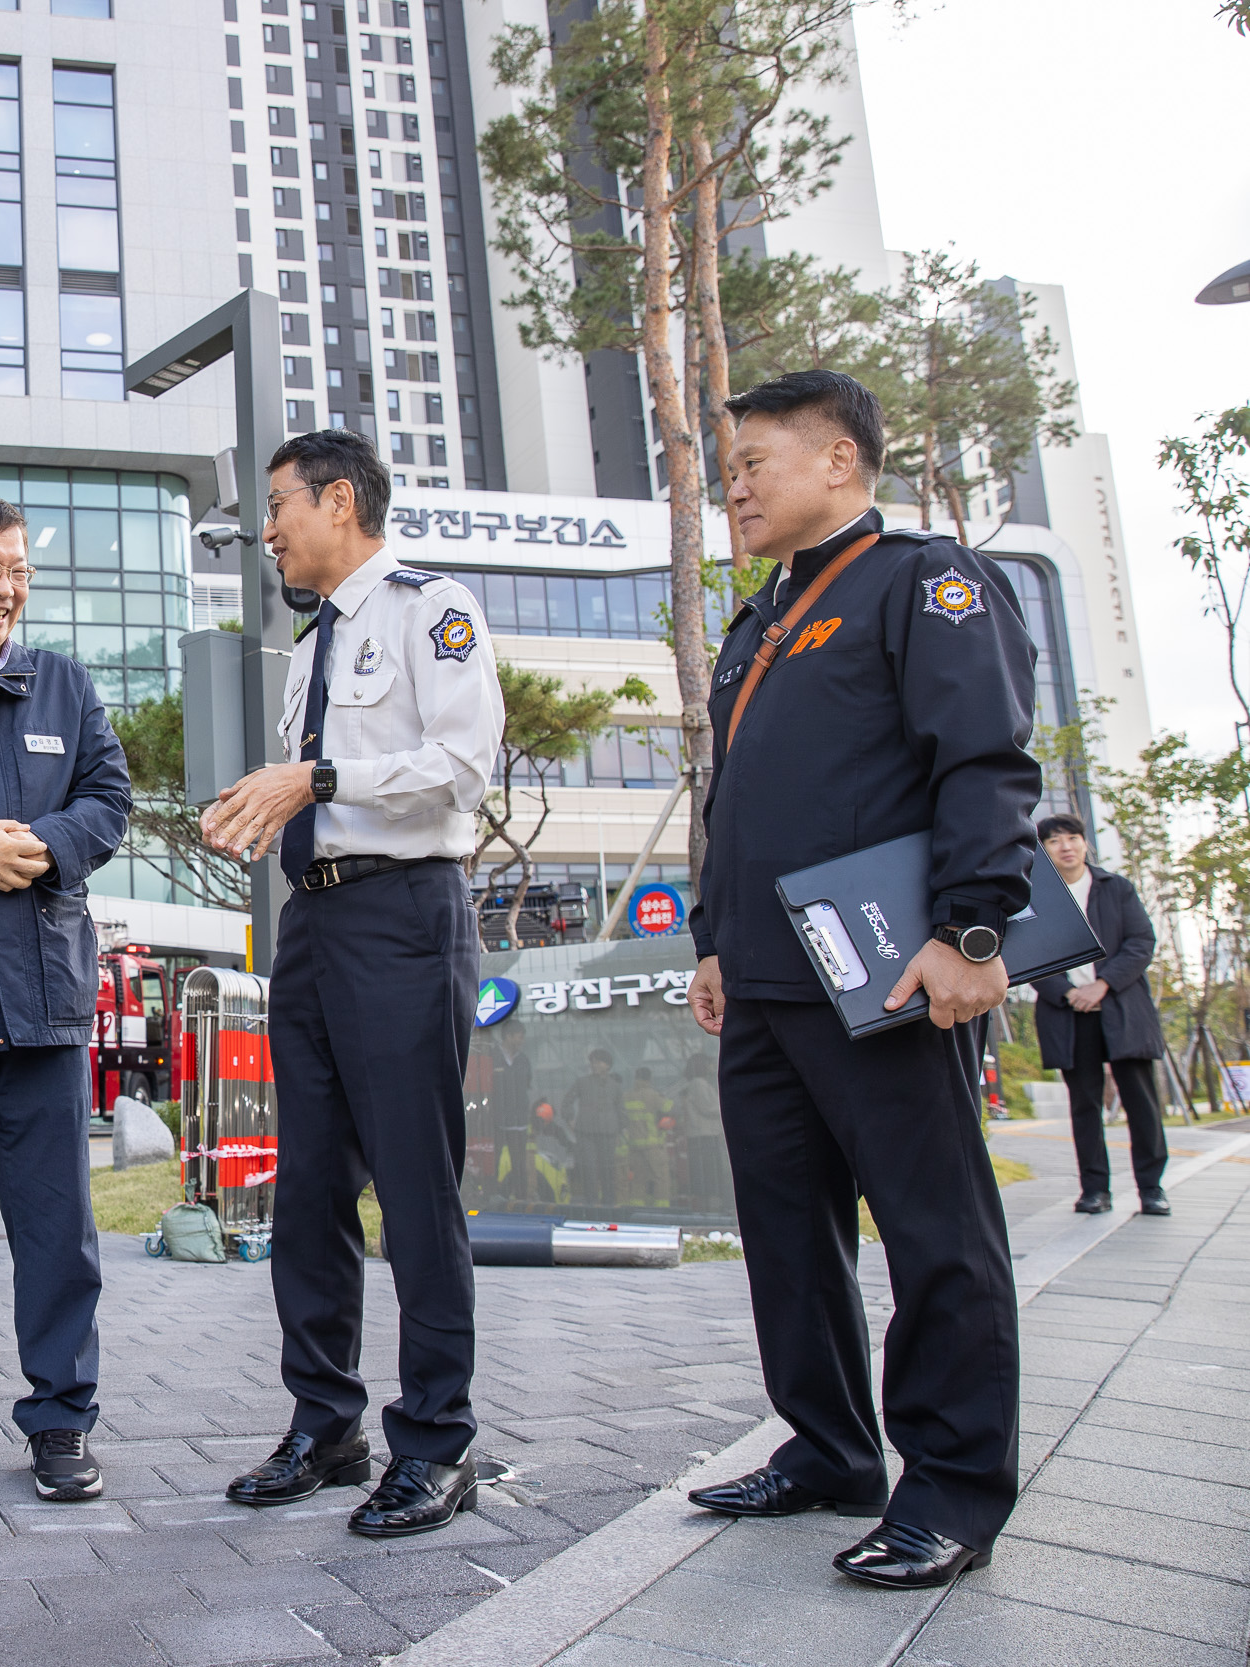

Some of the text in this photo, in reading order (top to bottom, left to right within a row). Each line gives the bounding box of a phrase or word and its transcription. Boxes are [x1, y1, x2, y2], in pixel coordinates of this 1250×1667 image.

[391, 507, 627, 549] 광진구보건소
[945, 591, 964, 600] 119
[450, 628, 465, 640] 119
[641, 899, 672, 912] 상수도
[640, 912, 672, 925] 소화전
[860, 902, 900, 960] Report
[526, 969, 697, 1014] 광진구청
